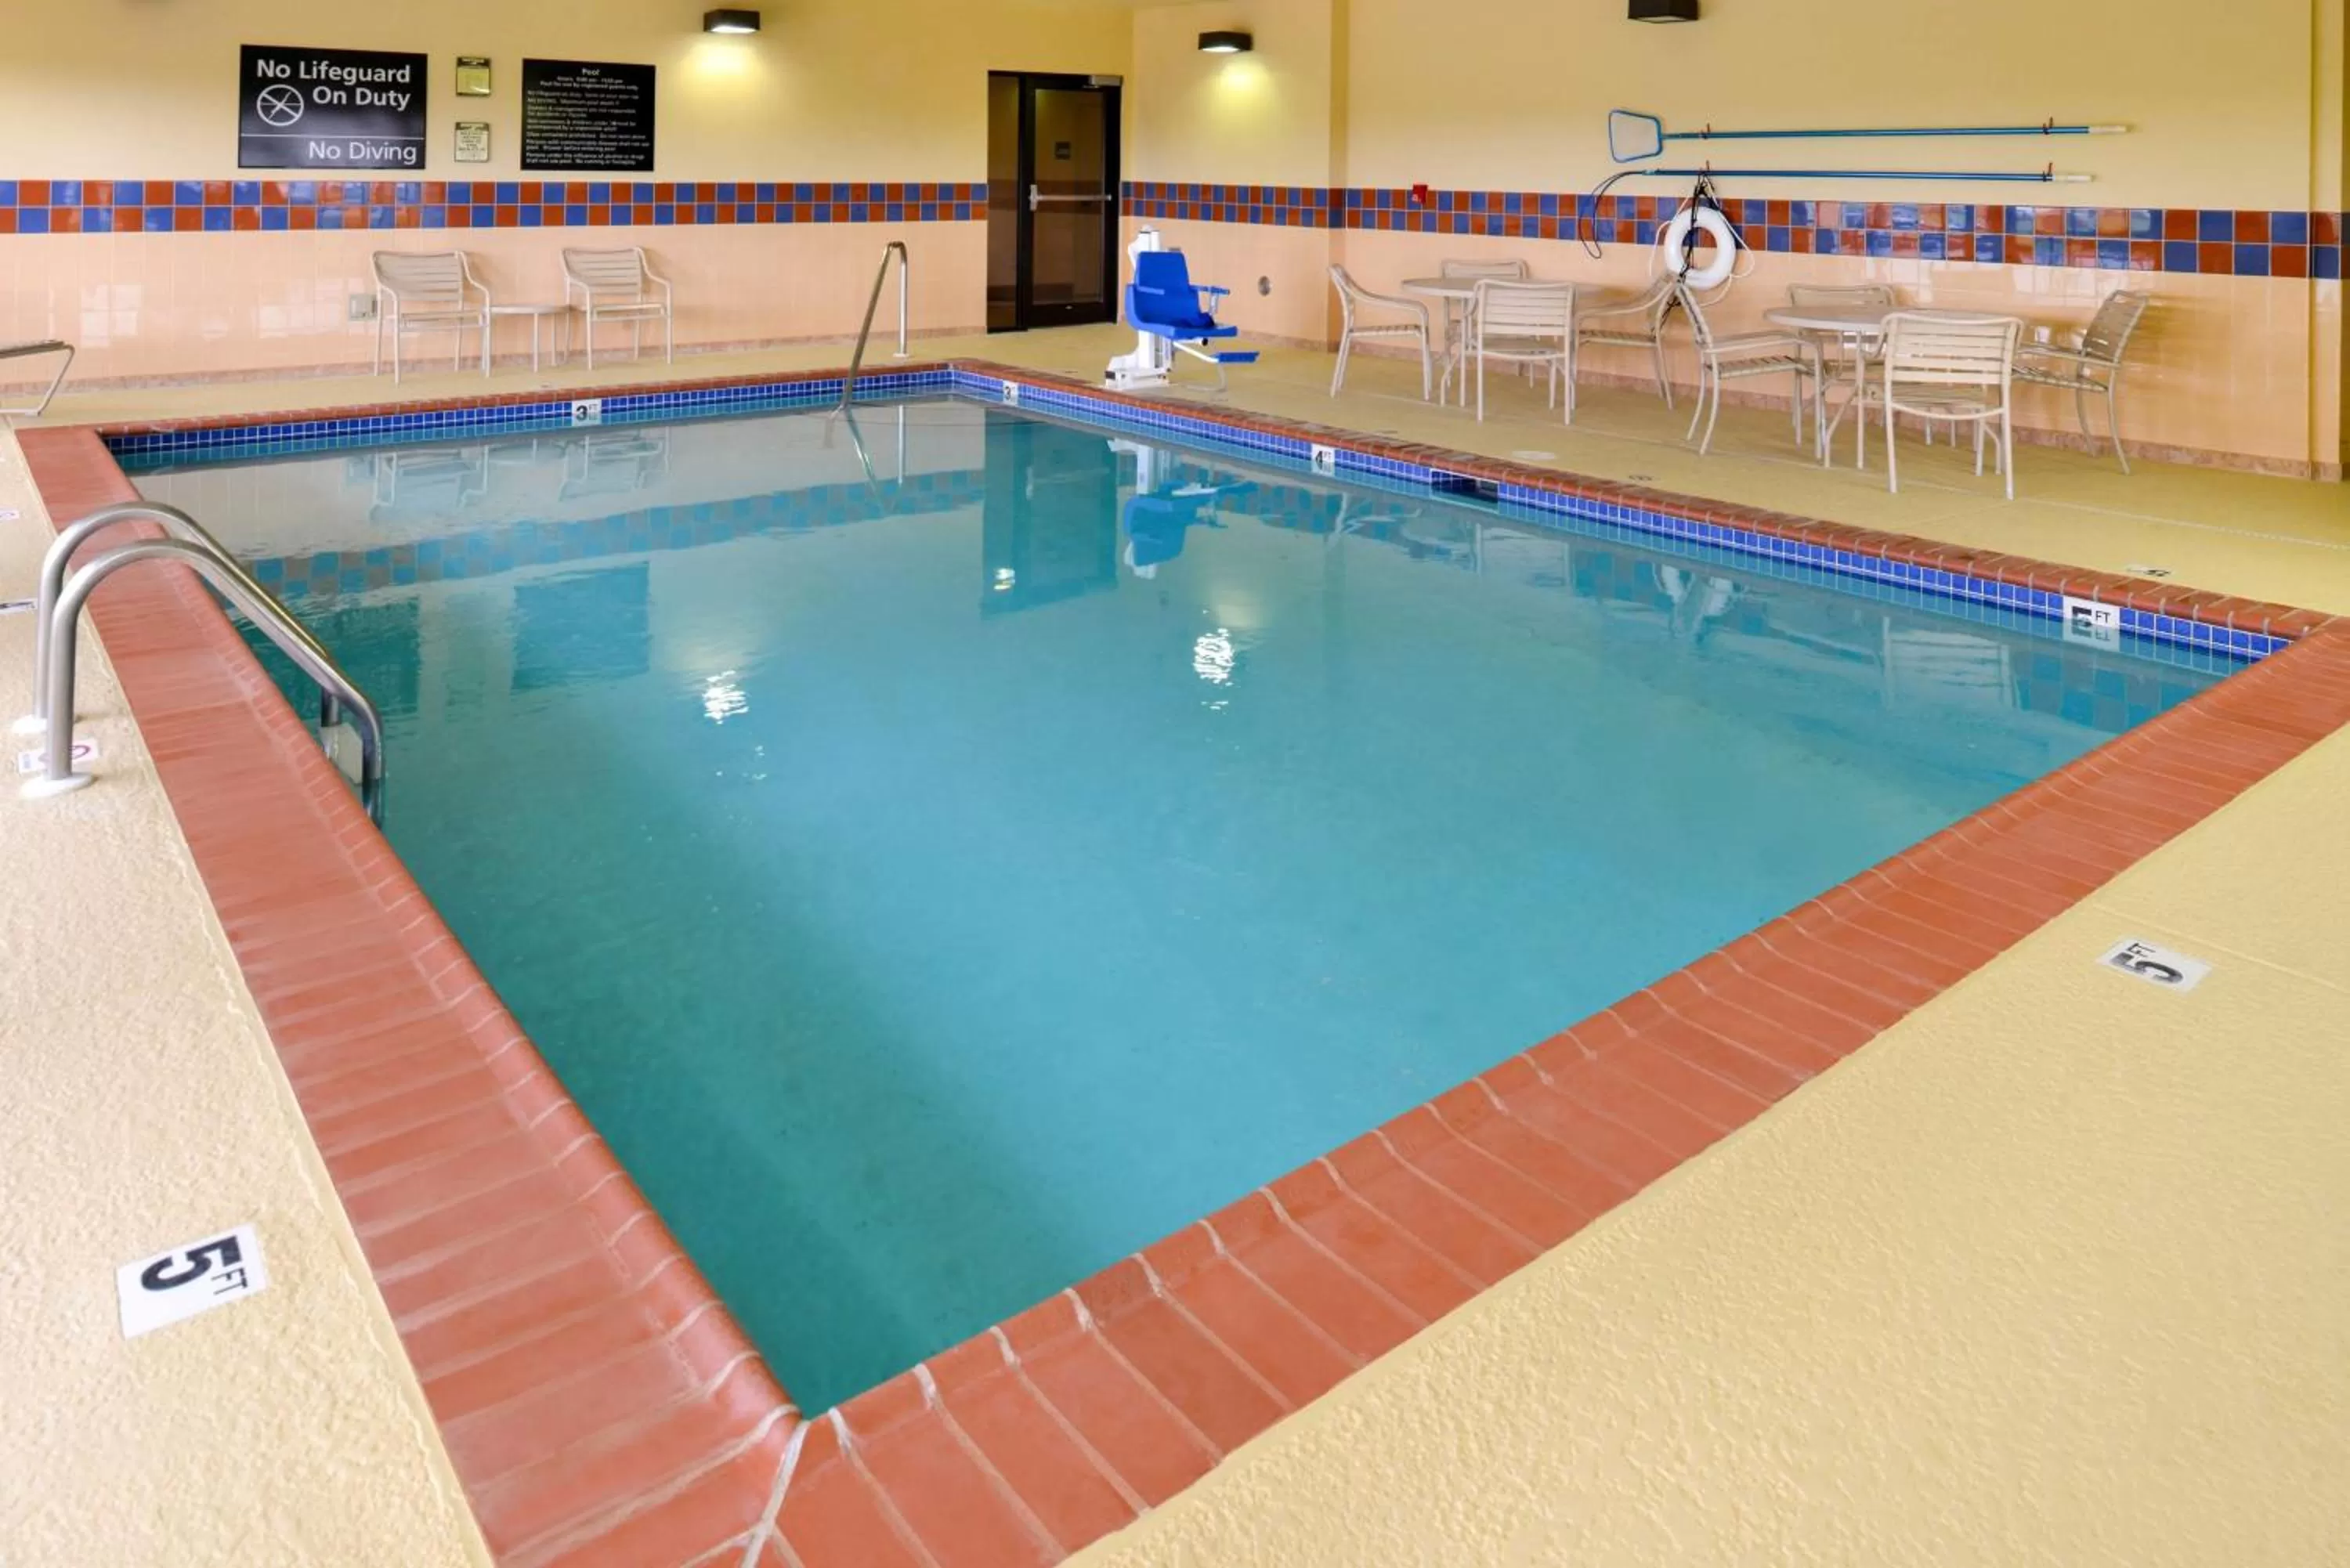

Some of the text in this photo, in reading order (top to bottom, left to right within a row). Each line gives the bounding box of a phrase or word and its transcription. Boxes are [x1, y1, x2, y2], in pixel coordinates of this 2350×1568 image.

[257, 59, 410, 85] No Lifeguard
[313, 86, 411, 111] On Duty
[309, 141, 418, 165] No Diving
[577, 405, 588, 421] 3
[2095, 610, 2112, 624] FT
[2111, 942, 2184, 985] 5 FT
[140, 1234, 248, 1295] 5 FT
